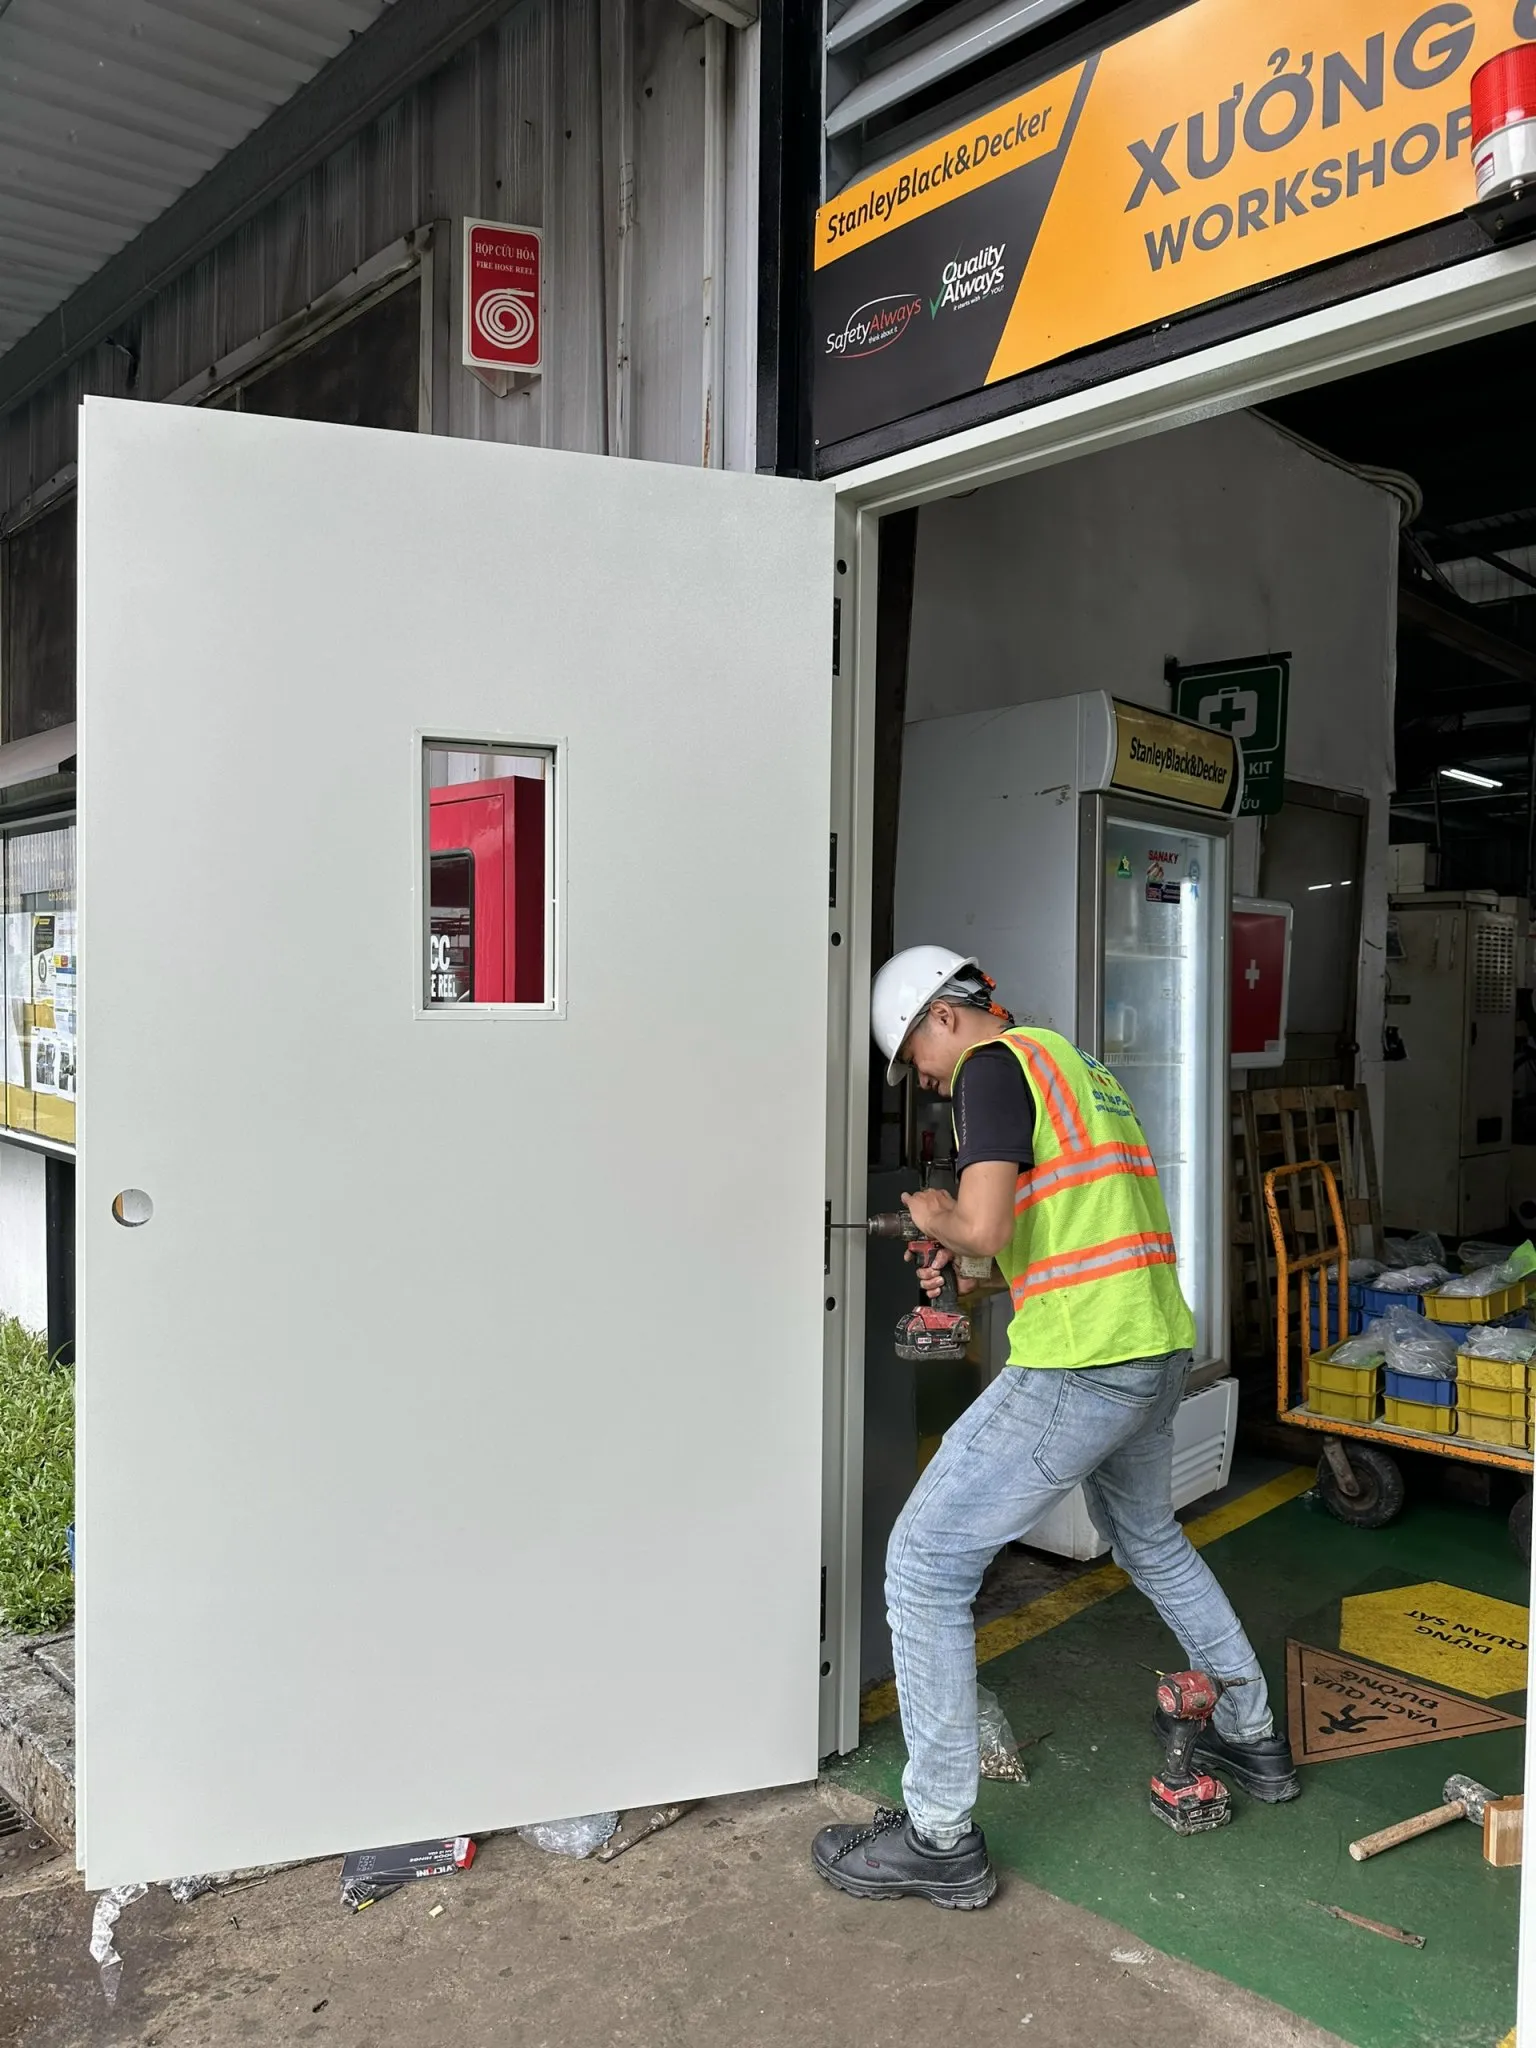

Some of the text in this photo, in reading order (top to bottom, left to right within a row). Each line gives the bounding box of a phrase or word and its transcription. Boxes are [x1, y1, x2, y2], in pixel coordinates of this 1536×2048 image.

[1124, 2, 1476, 213] XƯỞNG
[827, 105, 1052, 244] StanleyBlack&Decker
[1144, 104, 1472, 272] WORKSHOP
[476, 260, 535, 276] FIRE HOSE REEL
[942, 243, 1006, 285] Quality
[941, 265, 1005, 308] Always
[1129, 736, 1227, 784] StanleyBlack&Decker
[1249, 760, 1273, 776] KIT
[1148, 850, 1179, 864] SANAKY
[438, 974, 457, 998] REEL
[1404, 1609, 1528, 1651] QUAN SÁT
[1312, 1675, 1438, 1729] VẠCH QUA
